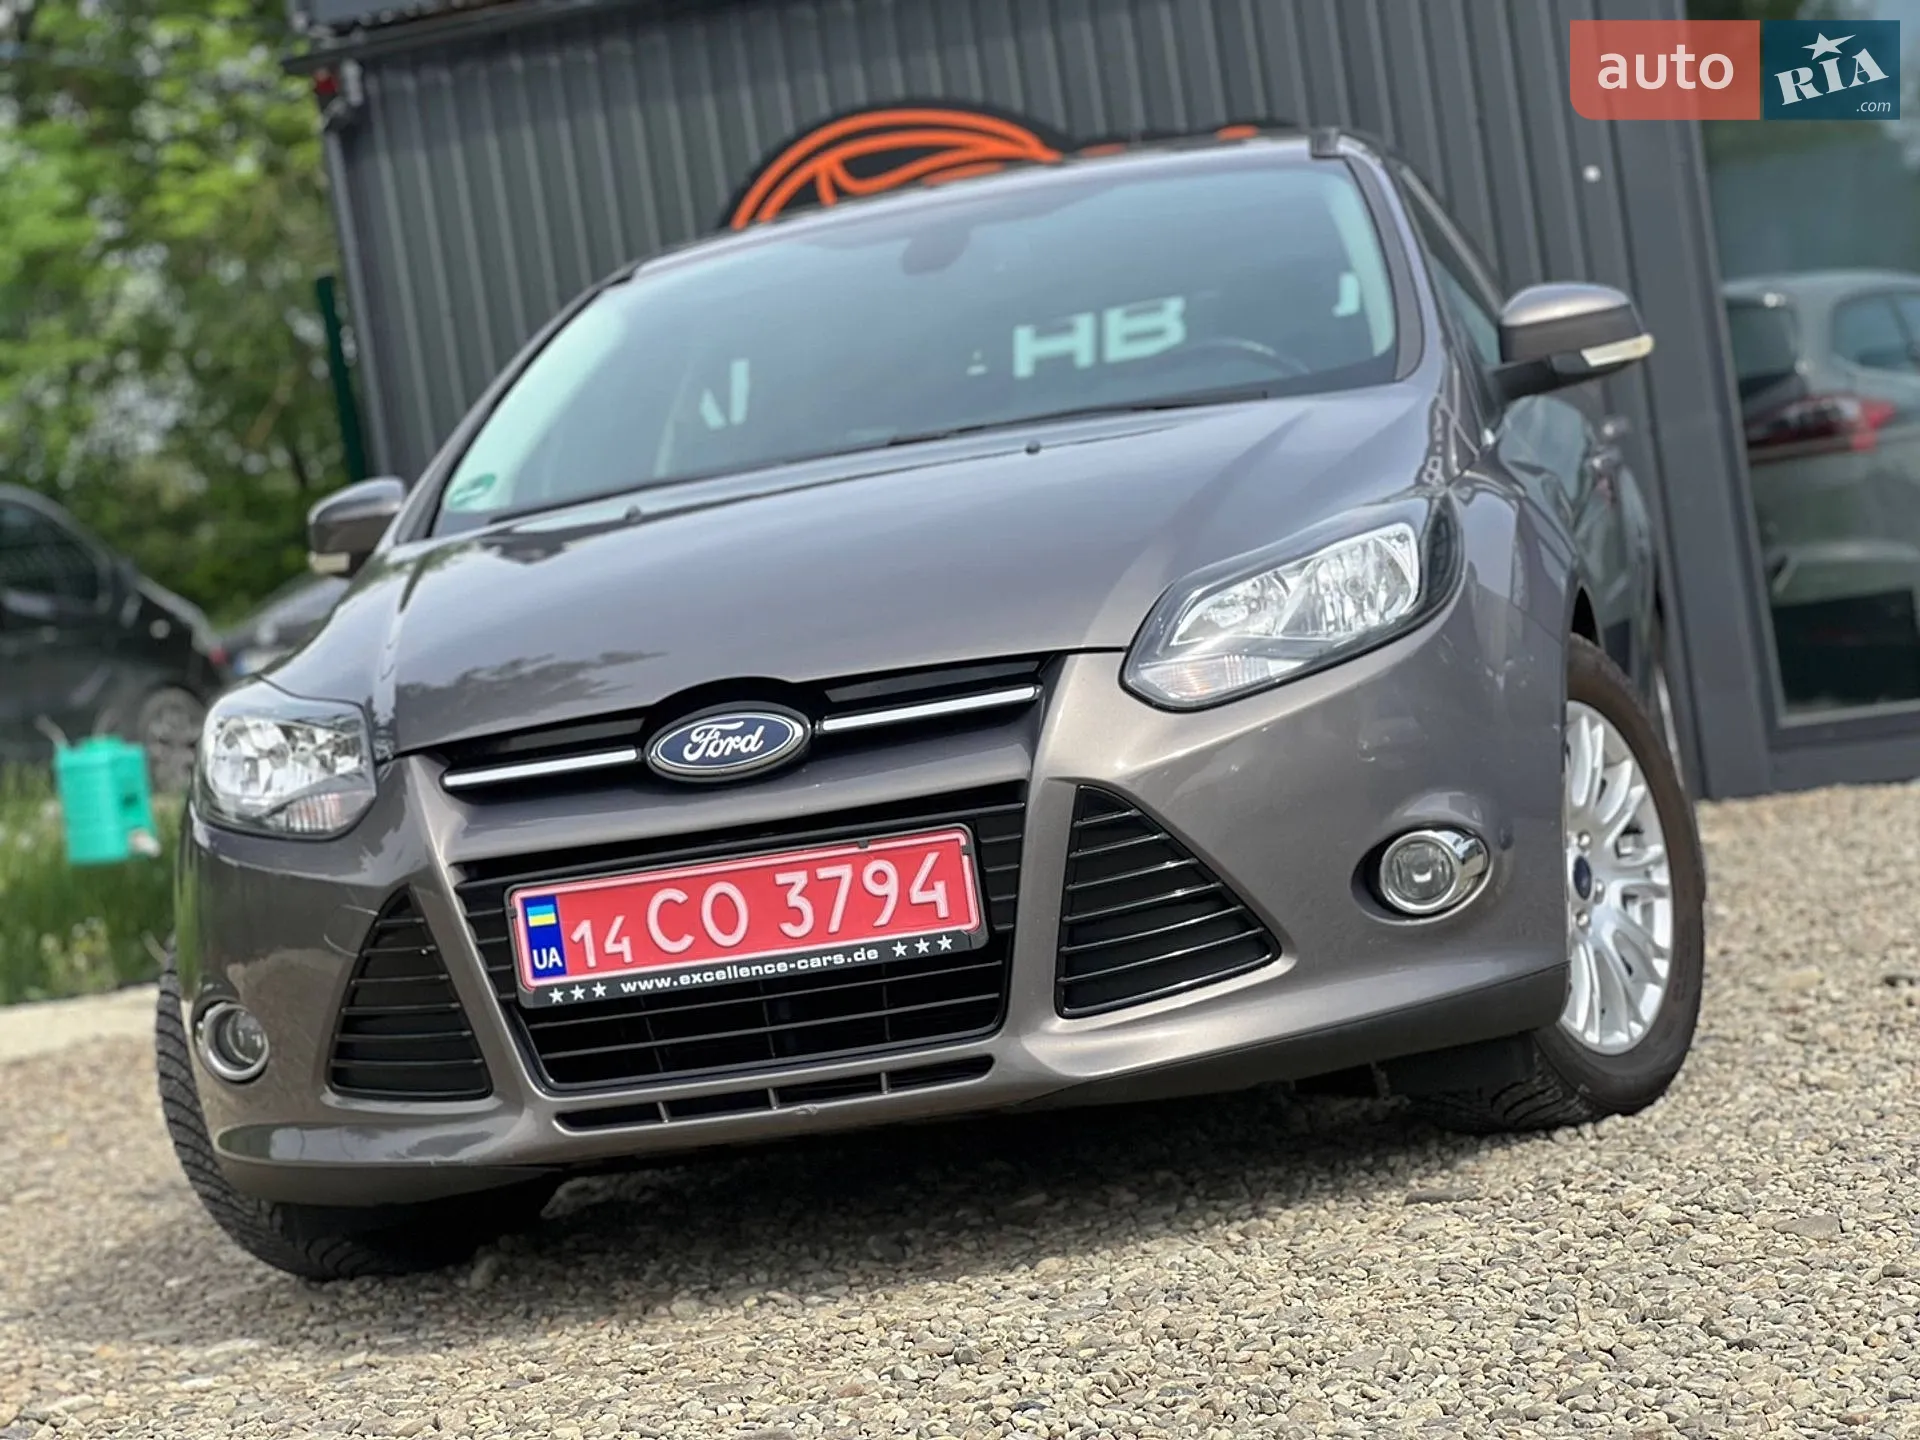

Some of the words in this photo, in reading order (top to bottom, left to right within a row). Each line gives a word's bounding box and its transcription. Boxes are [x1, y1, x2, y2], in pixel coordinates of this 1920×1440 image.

[683, 721, 765, 762] Ford
[570, 915, 635, 968] 14
[646, 880, 749, 954] CO
[774, 851, 952, 939] 3794
[532, 947, 564, 970] UA
[620, 946, 880, 994] www.excellence-cars.de
